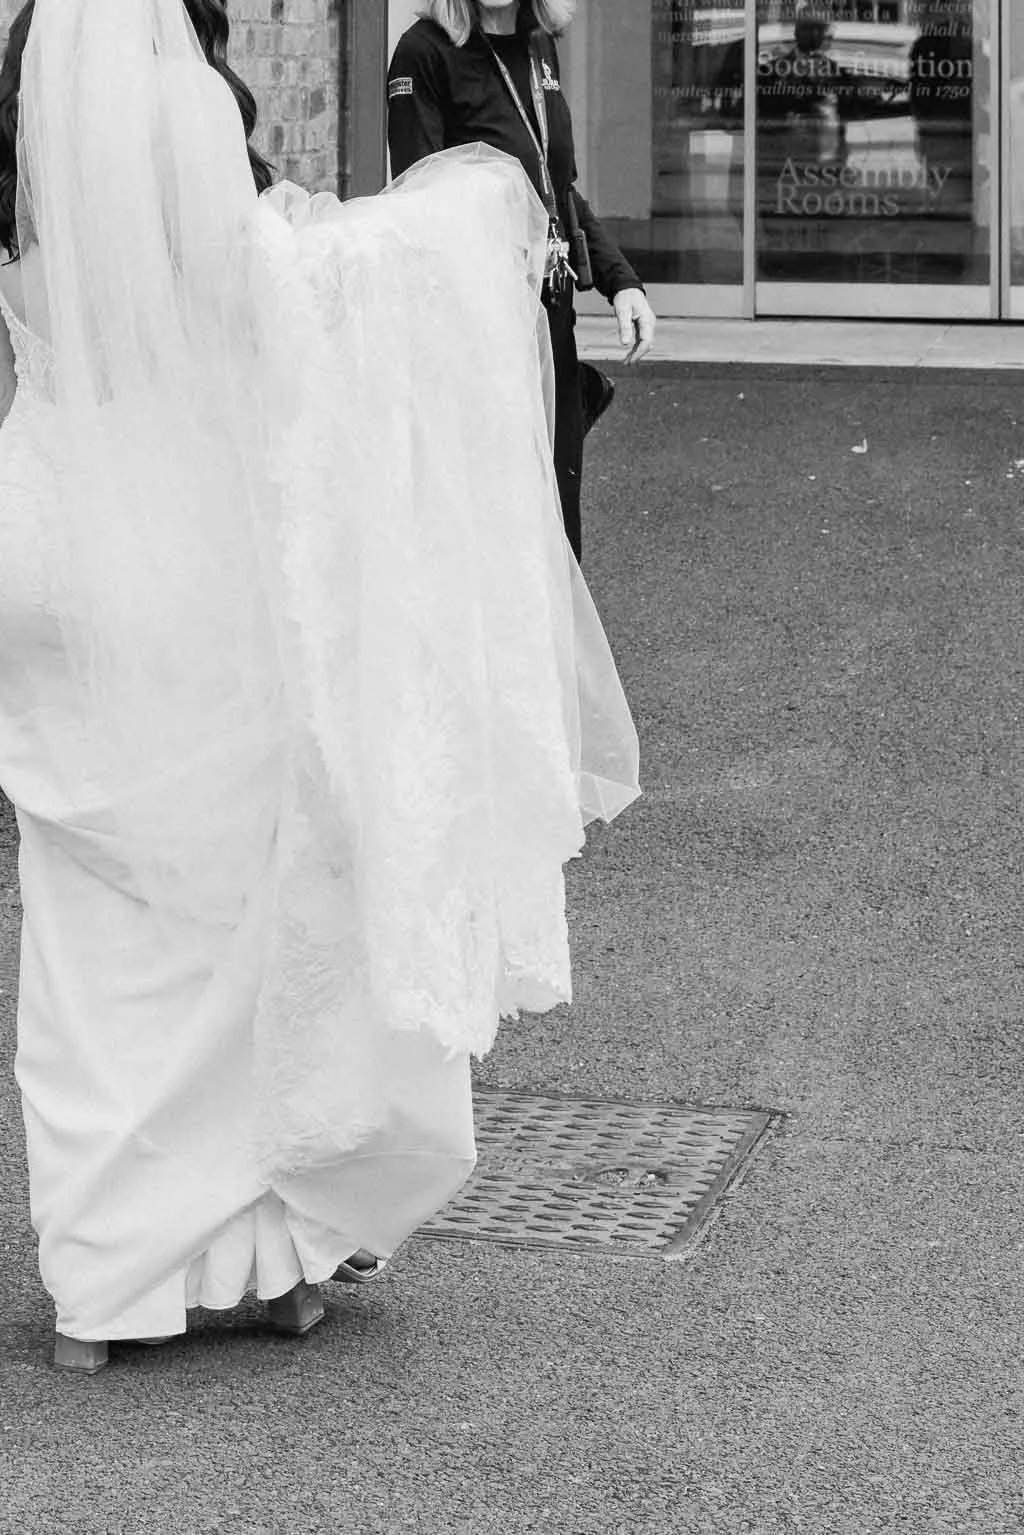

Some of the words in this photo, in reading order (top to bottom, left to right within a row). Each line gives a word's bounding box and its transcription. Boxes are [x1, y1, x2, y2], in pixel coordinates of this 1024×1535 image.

[934, 84, 970, 101] 1750
[777, 156, 952, 198] Assembly
[775, 183, 901, 216] Rooms
